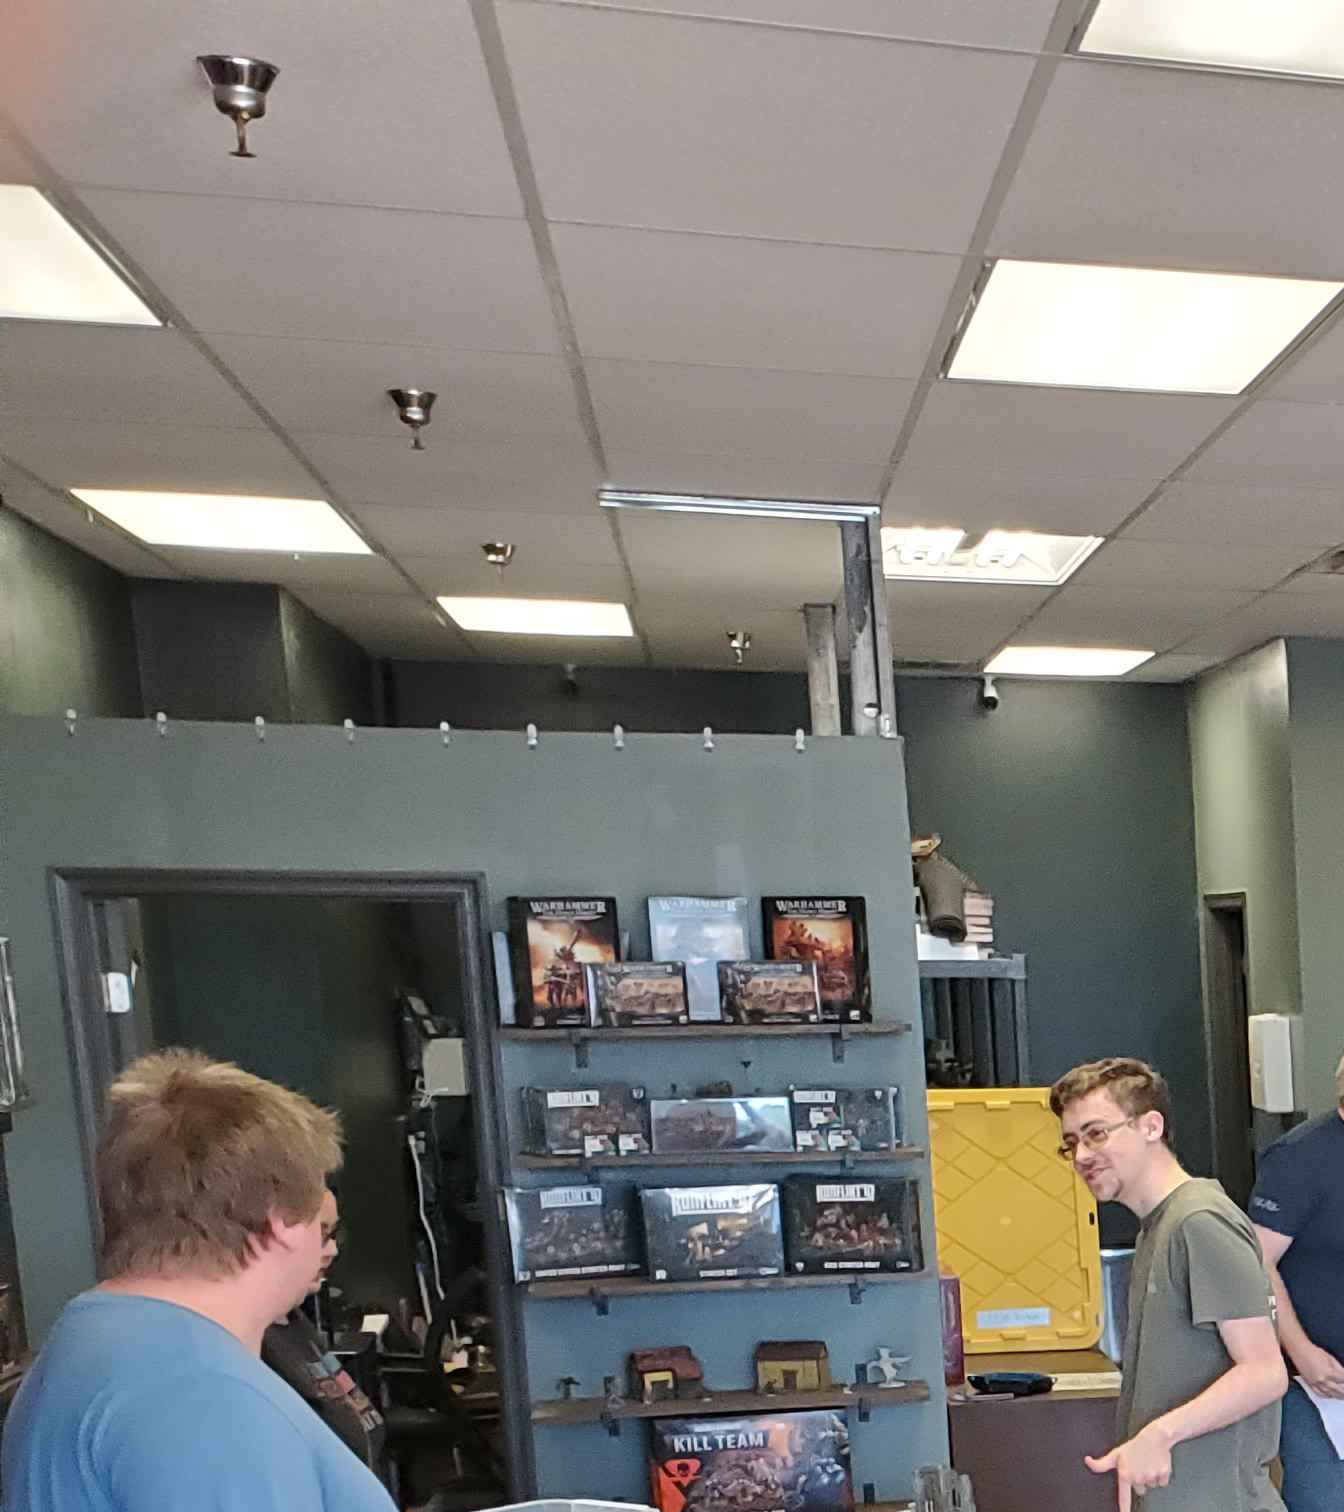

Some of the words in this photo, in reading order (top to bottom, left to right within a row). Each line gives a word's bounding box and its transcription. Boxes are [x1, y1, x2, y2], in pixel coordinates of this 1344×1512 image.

[530, 901, 607, 913] WARHAMMER
[776, 900, 847, 912] WARHAMMER
[674, 1434, 712, 1453] KILL
[714, 1432, 764, 1450] TEAM
